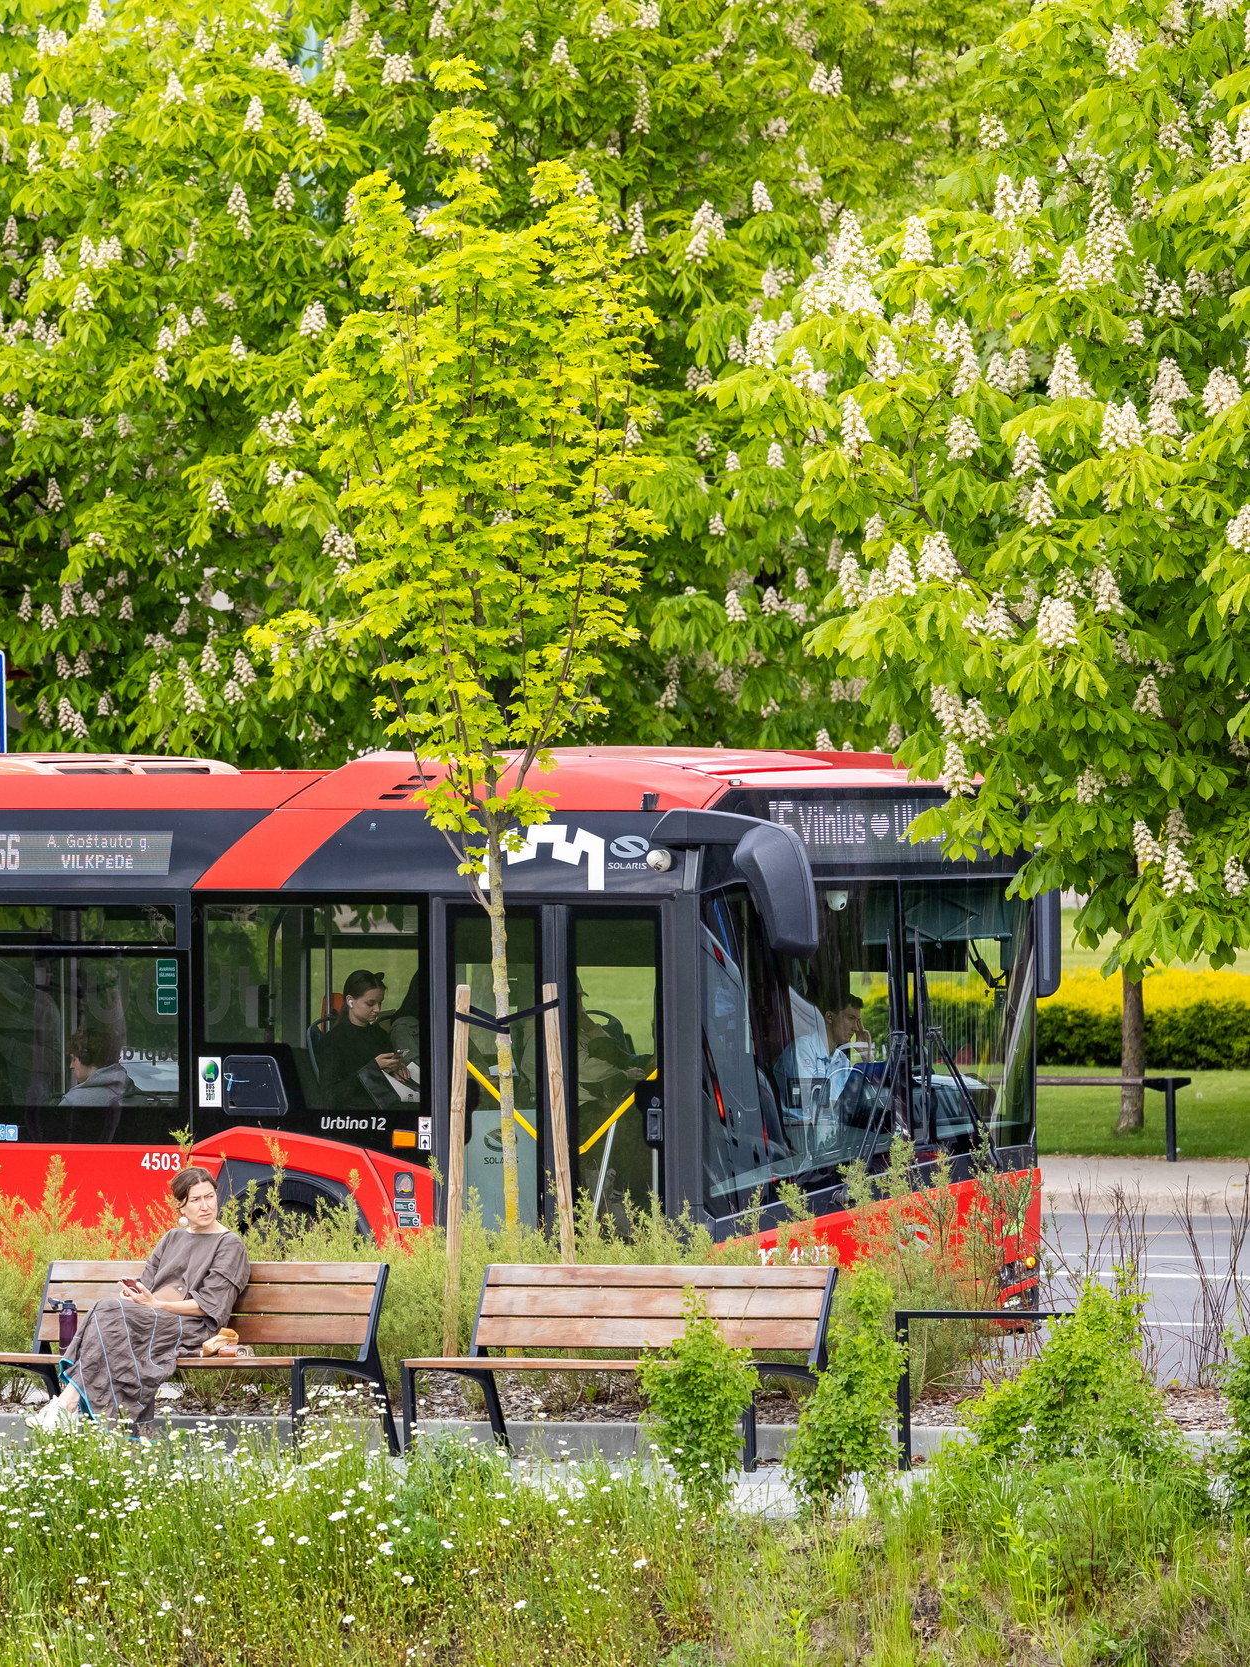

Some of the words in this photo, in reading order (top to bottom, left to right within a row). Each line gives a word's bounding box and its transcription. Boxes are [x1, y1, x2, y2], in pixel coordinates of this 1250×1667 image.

[798, 806, 866, 844] Vilnius
[47, 835, 60, 848] A.
[66, 834, 133, 848] Goštauto
[139, 837, 150, 852] g.
[607, 862, 647, 870] SOLARIS
[320, 1116, 368, 1130] Urbino
[370, 1116, 387, 1131] 12
[140, 1152, 181, 1171] 4503
